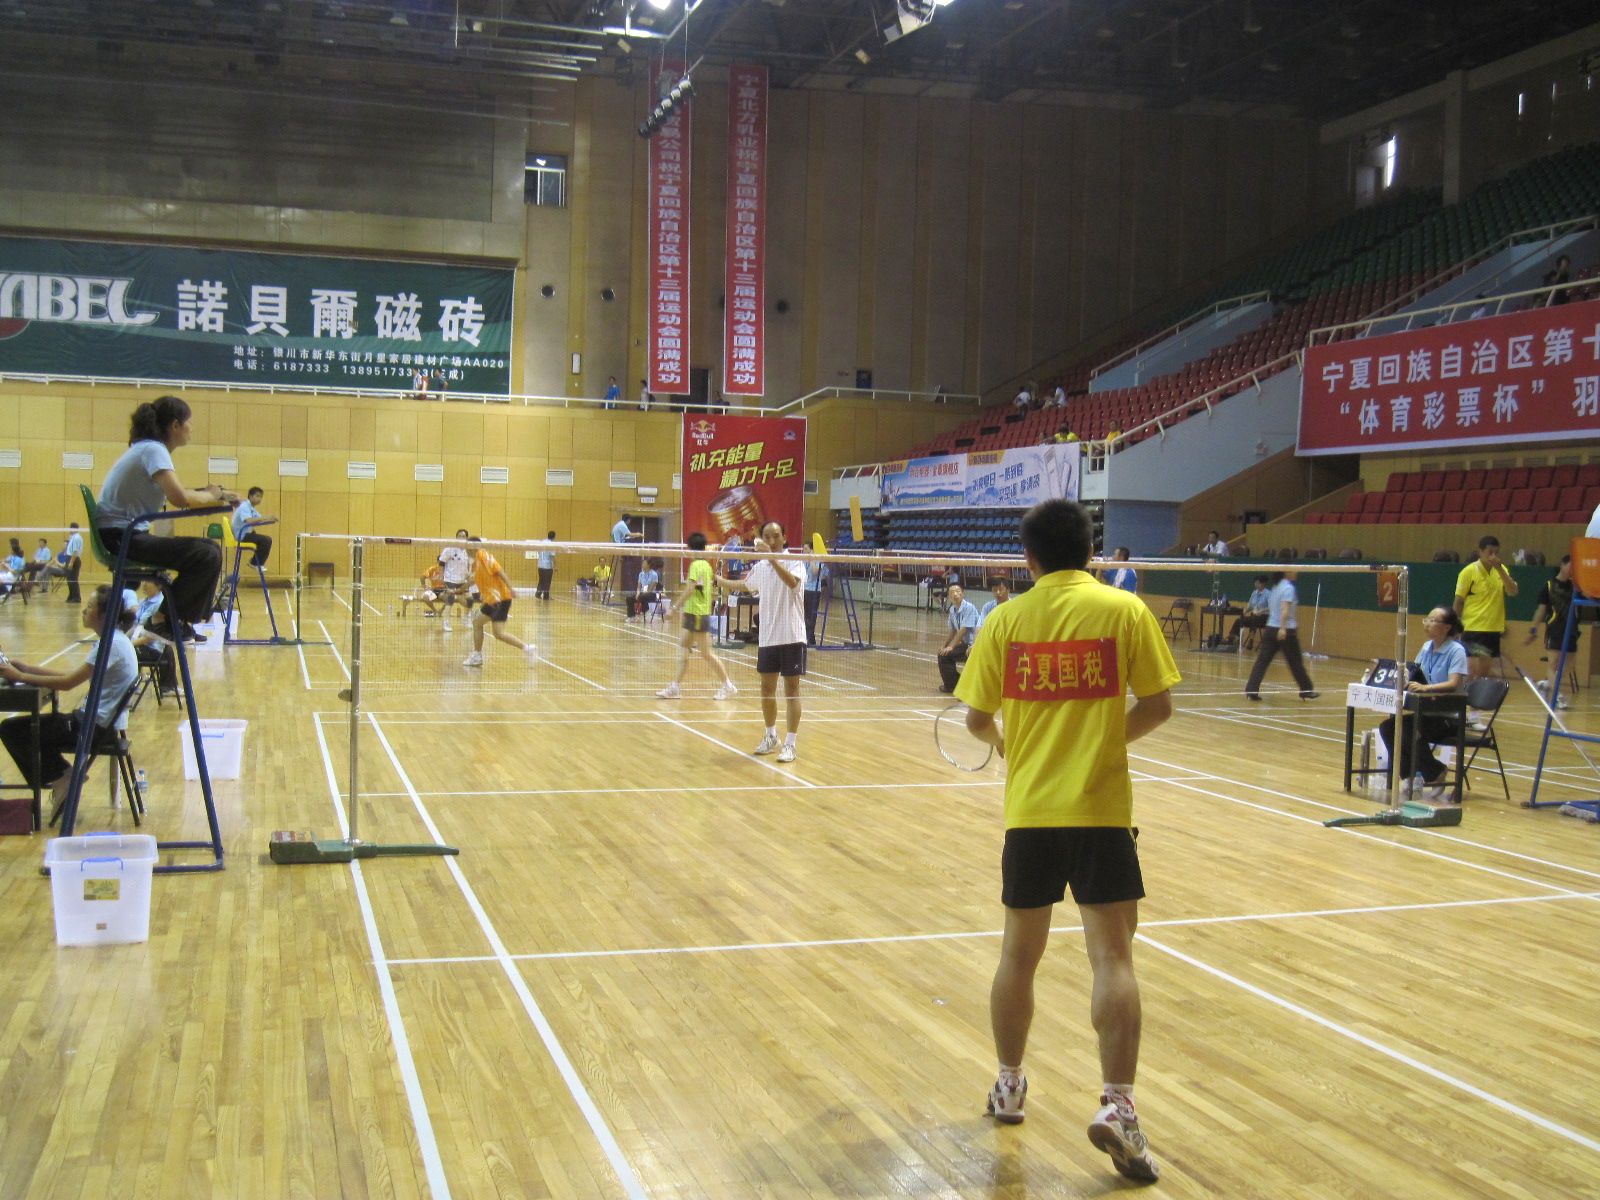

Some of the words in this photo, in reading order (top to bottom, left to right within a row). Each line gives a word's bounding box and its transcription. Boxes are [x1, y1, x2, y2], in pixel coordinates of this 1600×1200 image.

[0, 271, 160, 326] ABEL
[177, 278, 486, 347] 諾貝爾磁砖
[1321, 323, 1600, 394] 宁夏回族自治区第十
[690, 441, 764, 472] 补充能量
[719, 458, 797, 489] 精力十足
[1383, 581, 1392, 601] 2
[1015, 650, 1107, 692] 宁夏国税
[1373, 669, 1387, 683] 3
[1375, 693, 1397, 707] 国税
